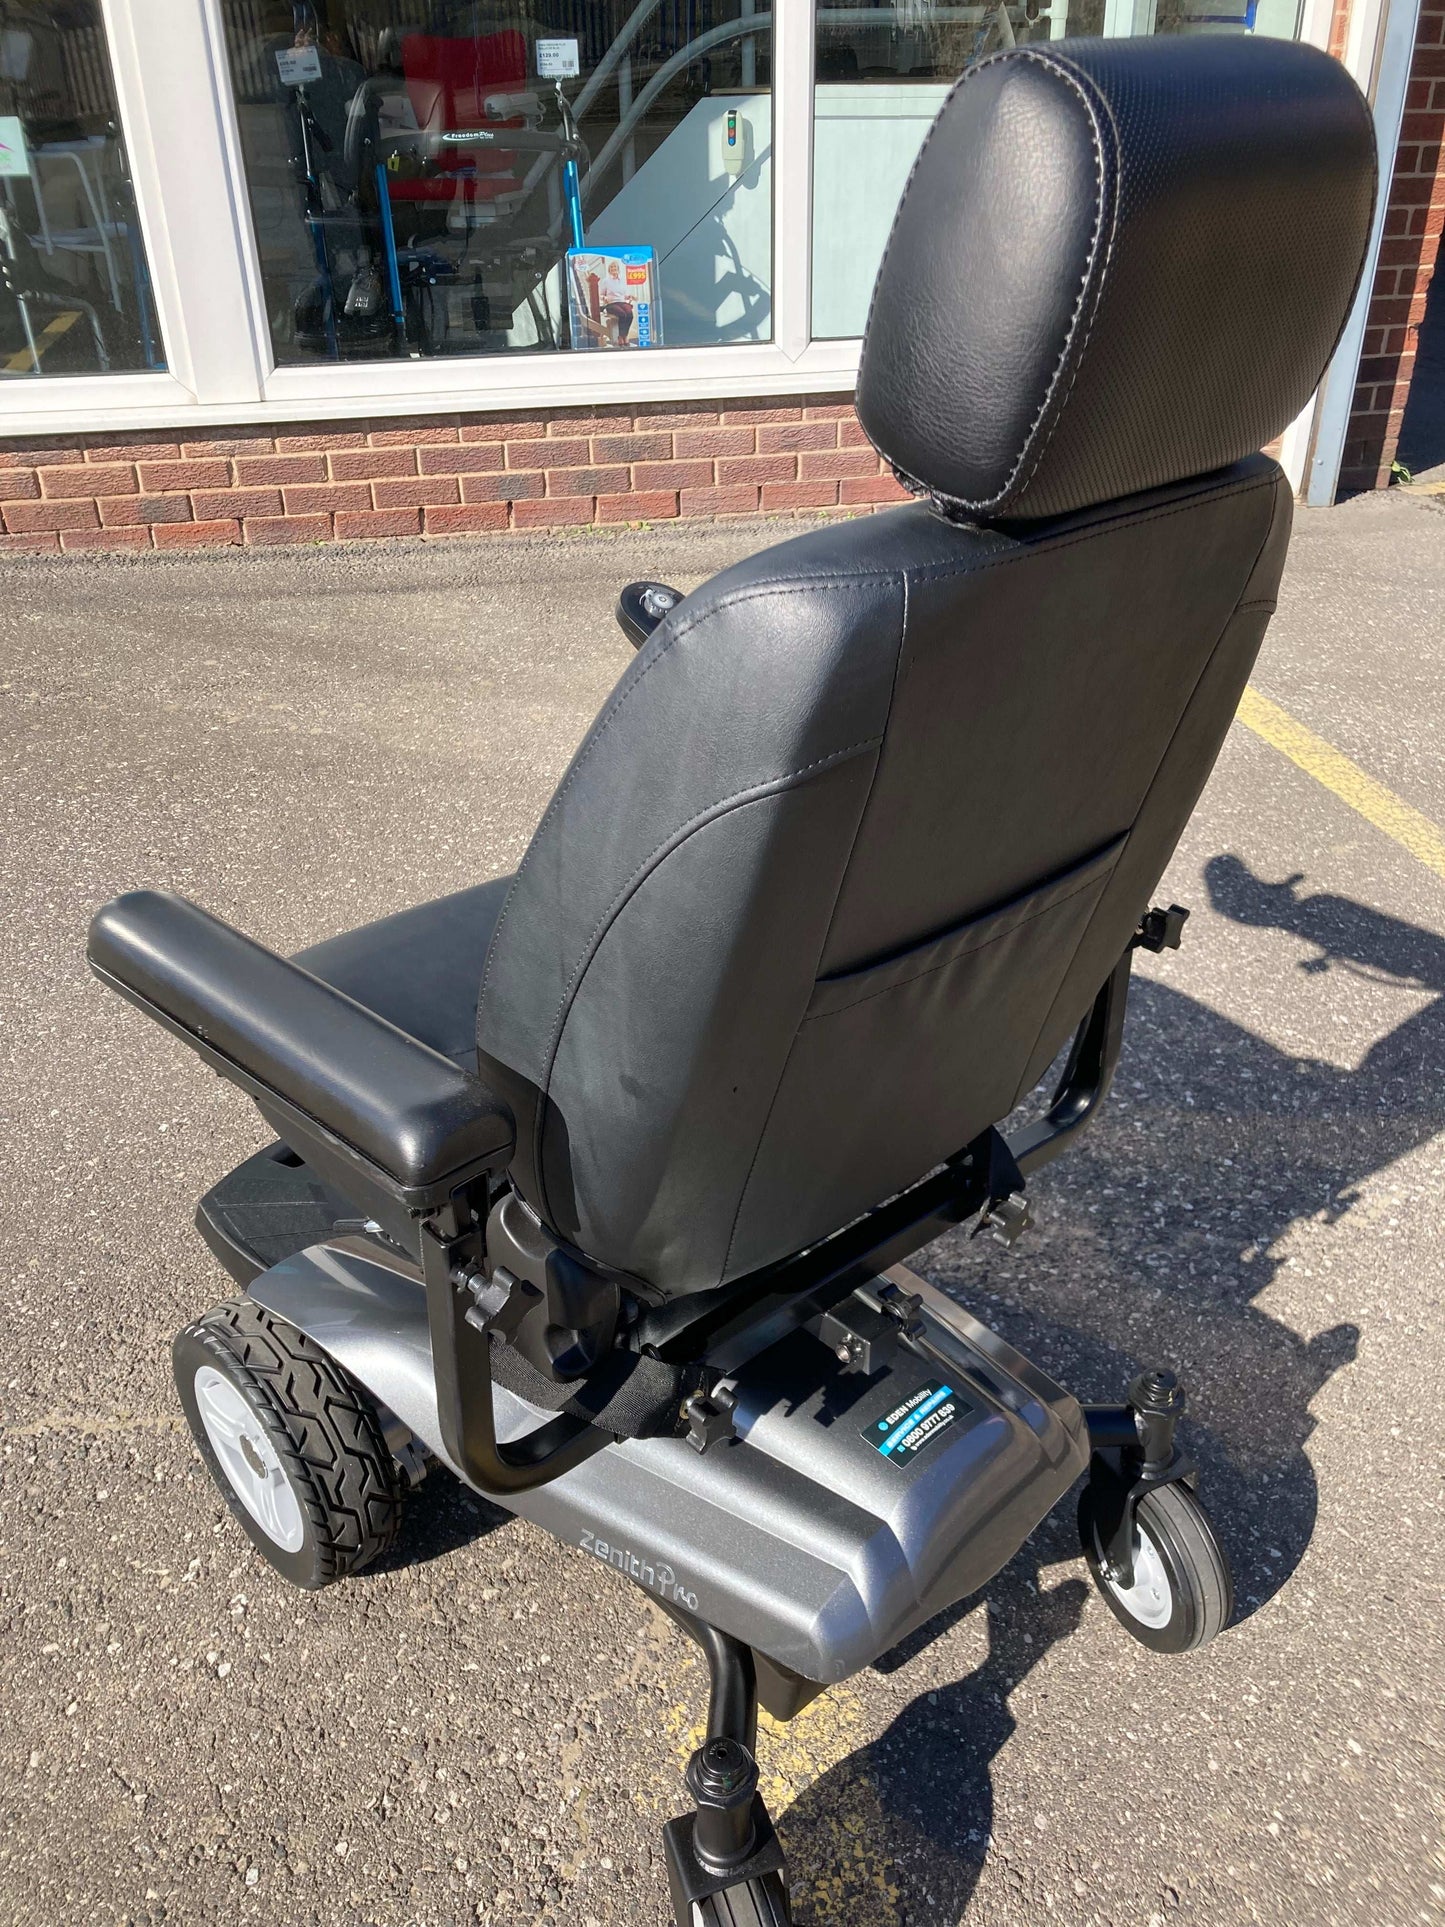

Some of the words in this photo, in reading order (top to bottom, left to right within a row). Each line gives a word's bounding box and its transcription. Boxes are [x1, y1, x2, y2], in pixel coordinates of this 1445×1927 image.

[885, 1405, 909, 1425] EDEN
[905, 1388, 933, 1409] Mobility
[886, 1419, 915, 1449] SERVICE
[901, 1427, 924, 1448] 0800
[920, 1412, 941, 1431] 9777
[579, 1527, 655, 1586] Zenith
[656, 1561, 699, 1611] Pro
